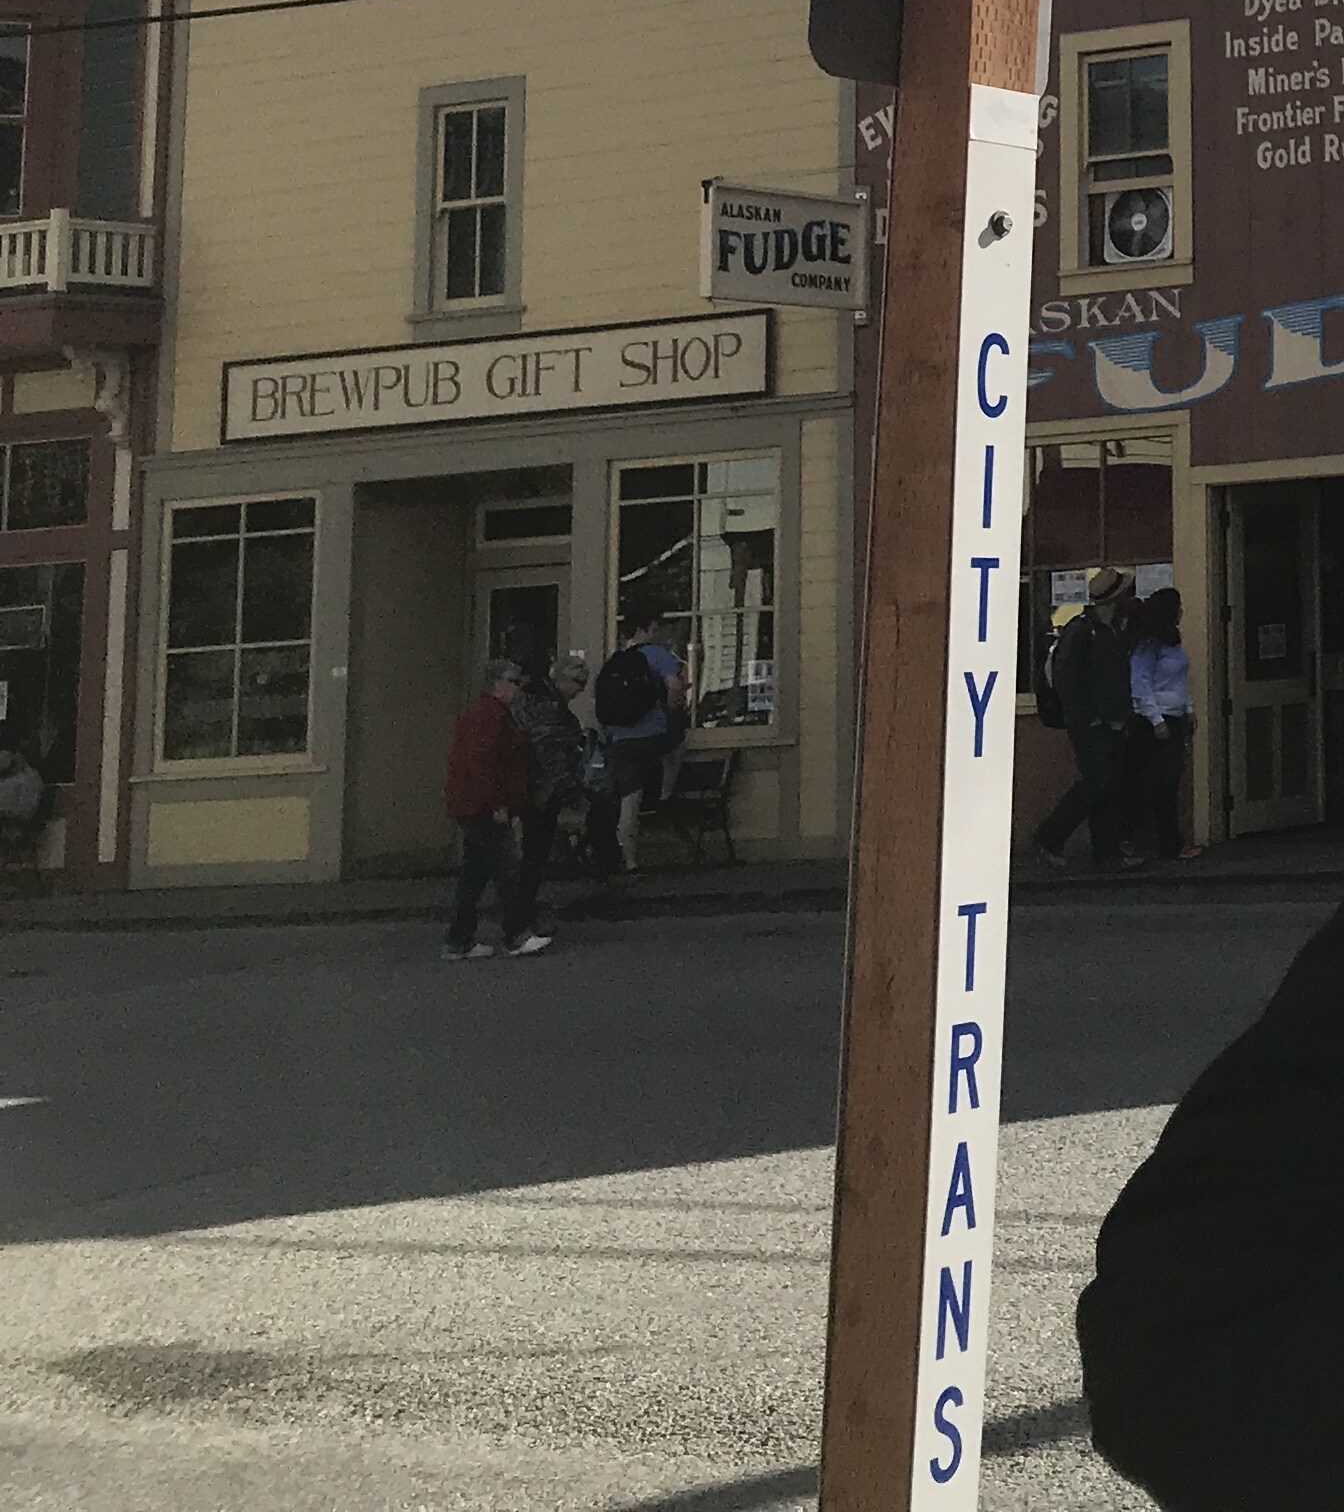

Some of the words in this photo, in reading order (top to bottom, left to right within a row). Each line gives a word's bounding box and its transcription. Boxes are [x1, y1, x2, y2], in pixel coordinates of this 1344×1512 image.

[1225, 25, 1299, 58] Inside
[1248, 60, 1331, 96] Miner's
[1236, 100, 1326, 135] Frontier
[1257, 136, 1312, 170] Gold
[720, 202, 782, 223] ALASKAN
[717, 220, 853, 275] FUDGE
[791, 272, 851, 292] COMPANY
[250, 360, 462, 423] BREWPUB
[485, 346, 593, 400] GIFT
[618, 332, 742, 389] SHOP
[964, 332, 1010, 758] CITY
